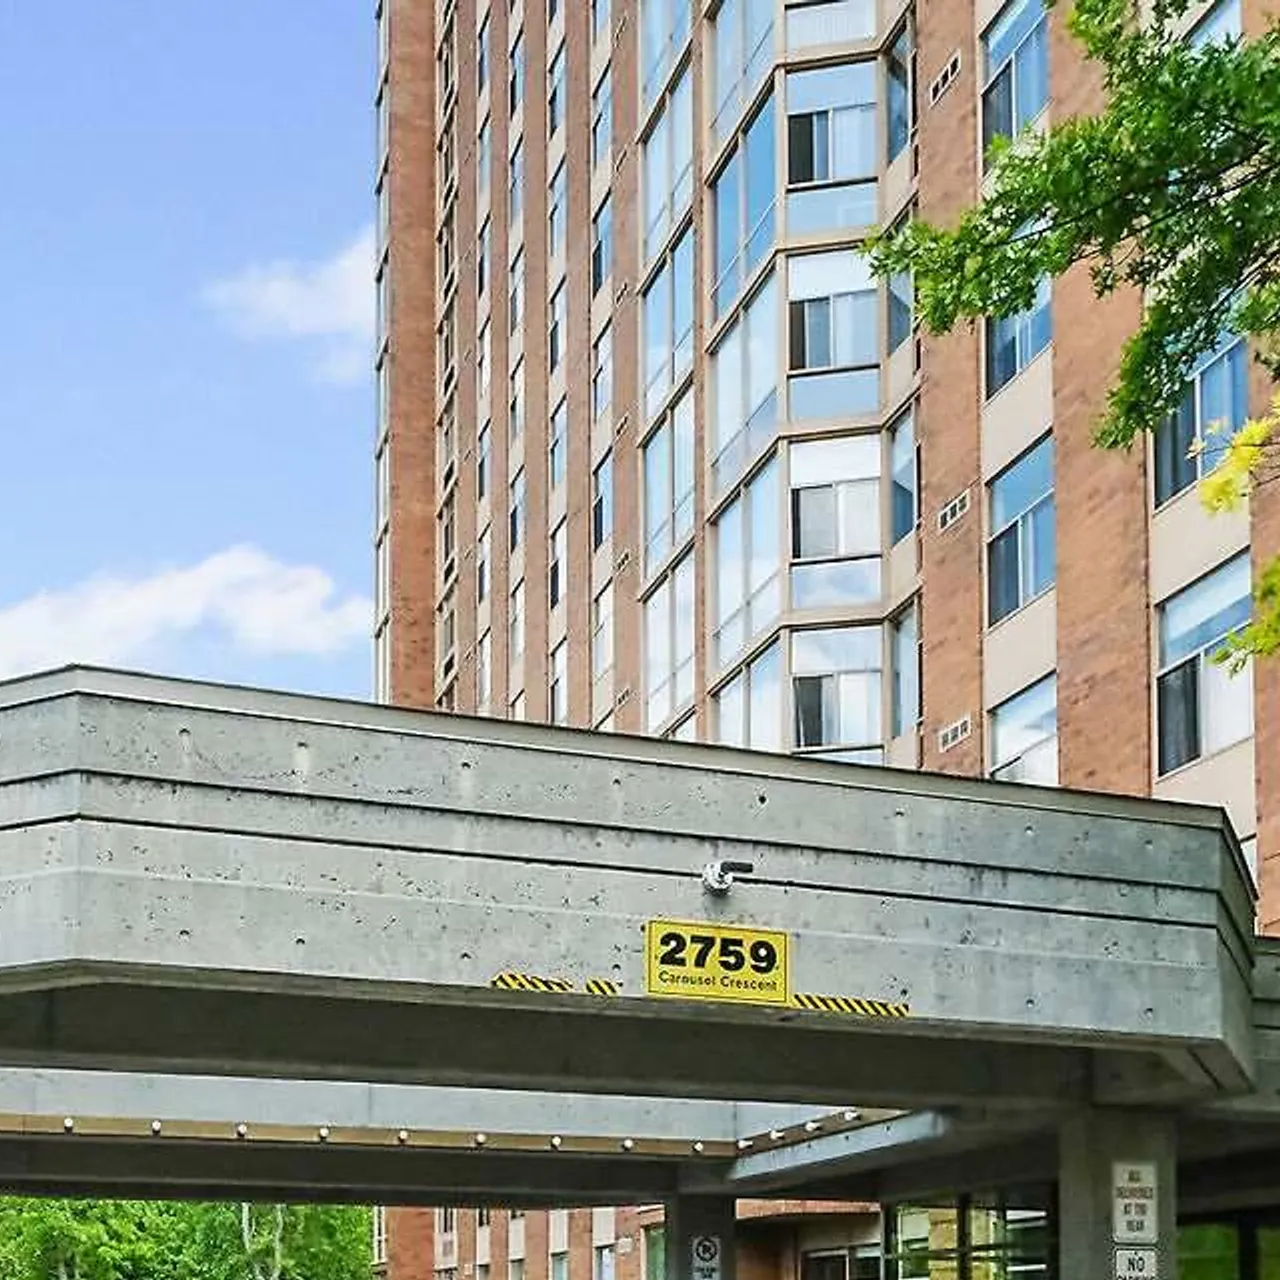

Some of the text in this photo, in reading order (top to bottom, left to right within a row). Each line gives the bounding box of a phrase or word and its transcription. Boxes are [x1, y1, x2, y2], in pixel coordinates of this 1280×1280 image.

[660, 932, 777, 974] 2759
[659, 970, 777, 991] Carousel Crescent
[1127, 1258, 1145, 1272] NO
